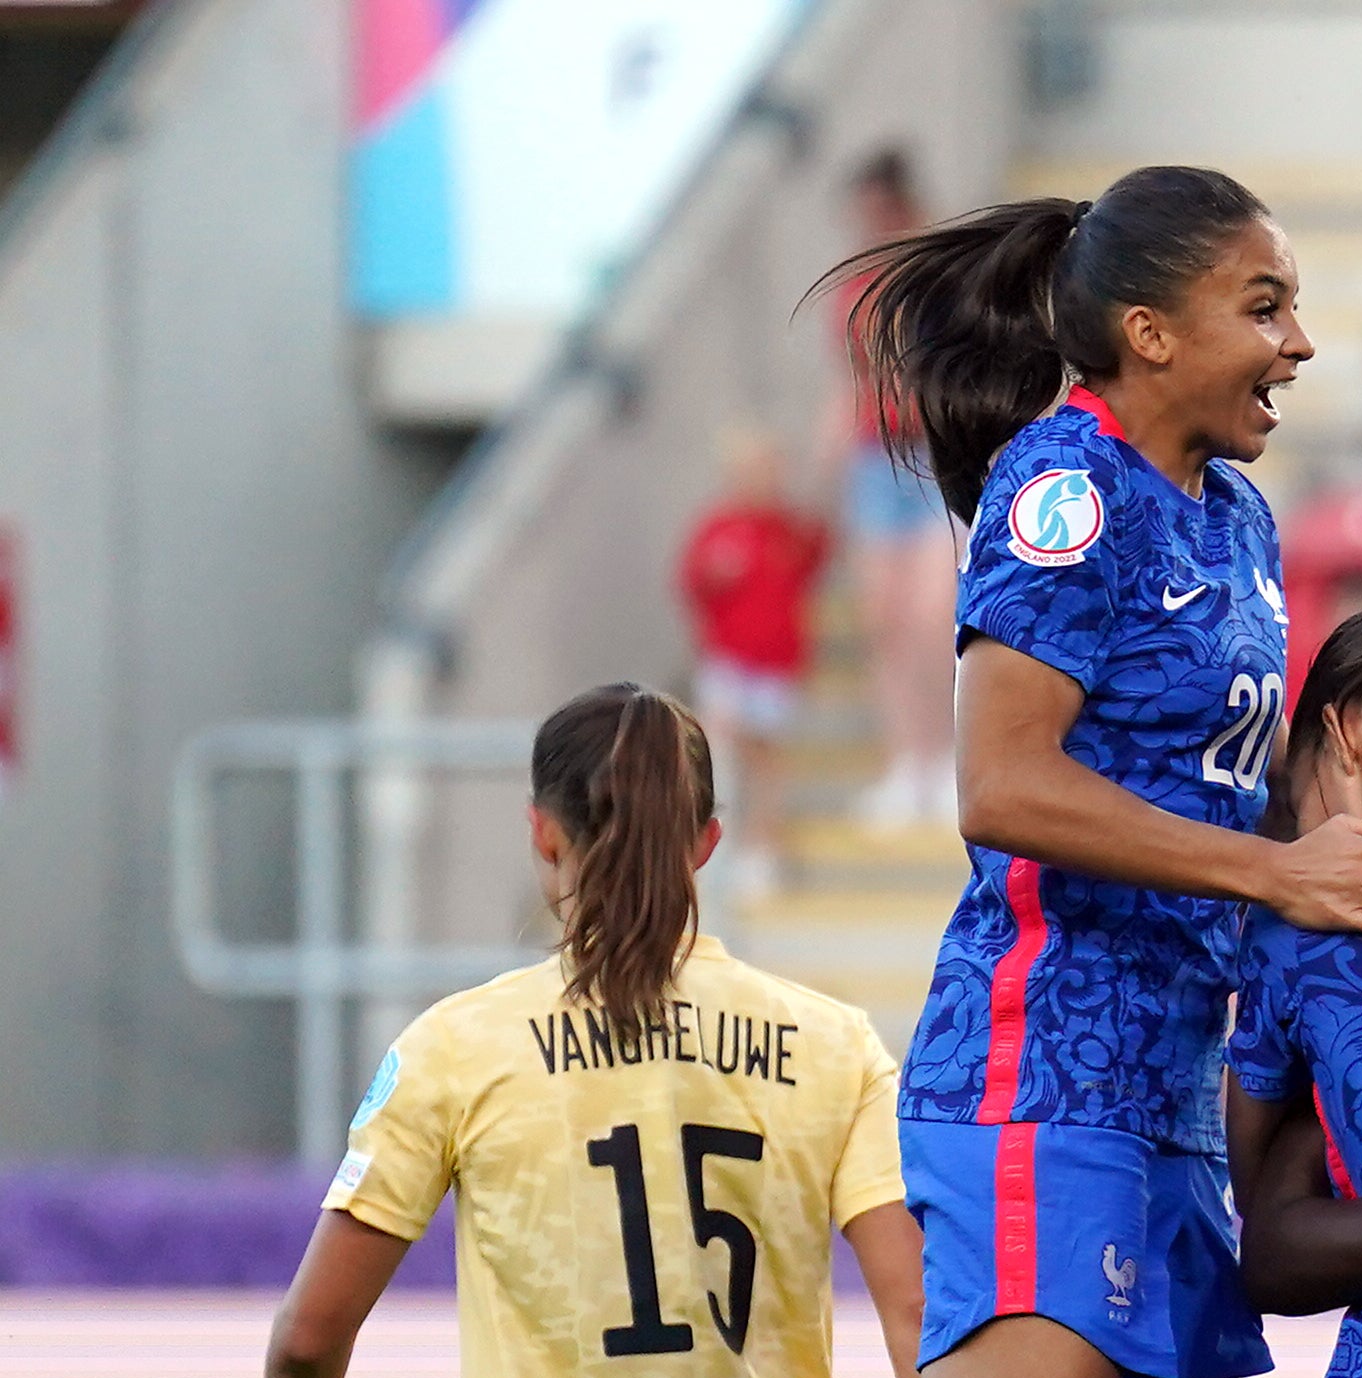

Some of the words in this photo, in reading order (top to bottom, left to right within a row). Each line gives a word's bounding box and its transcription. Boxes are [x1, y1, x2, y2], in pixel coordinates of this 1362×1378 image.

[1014, 543, 1051, 564] ENGLAND
[1053, 554, 1077, 563] 2022
[1202, 673, 1284, 791] 20
[586, 1122, 765, 1358] 15
